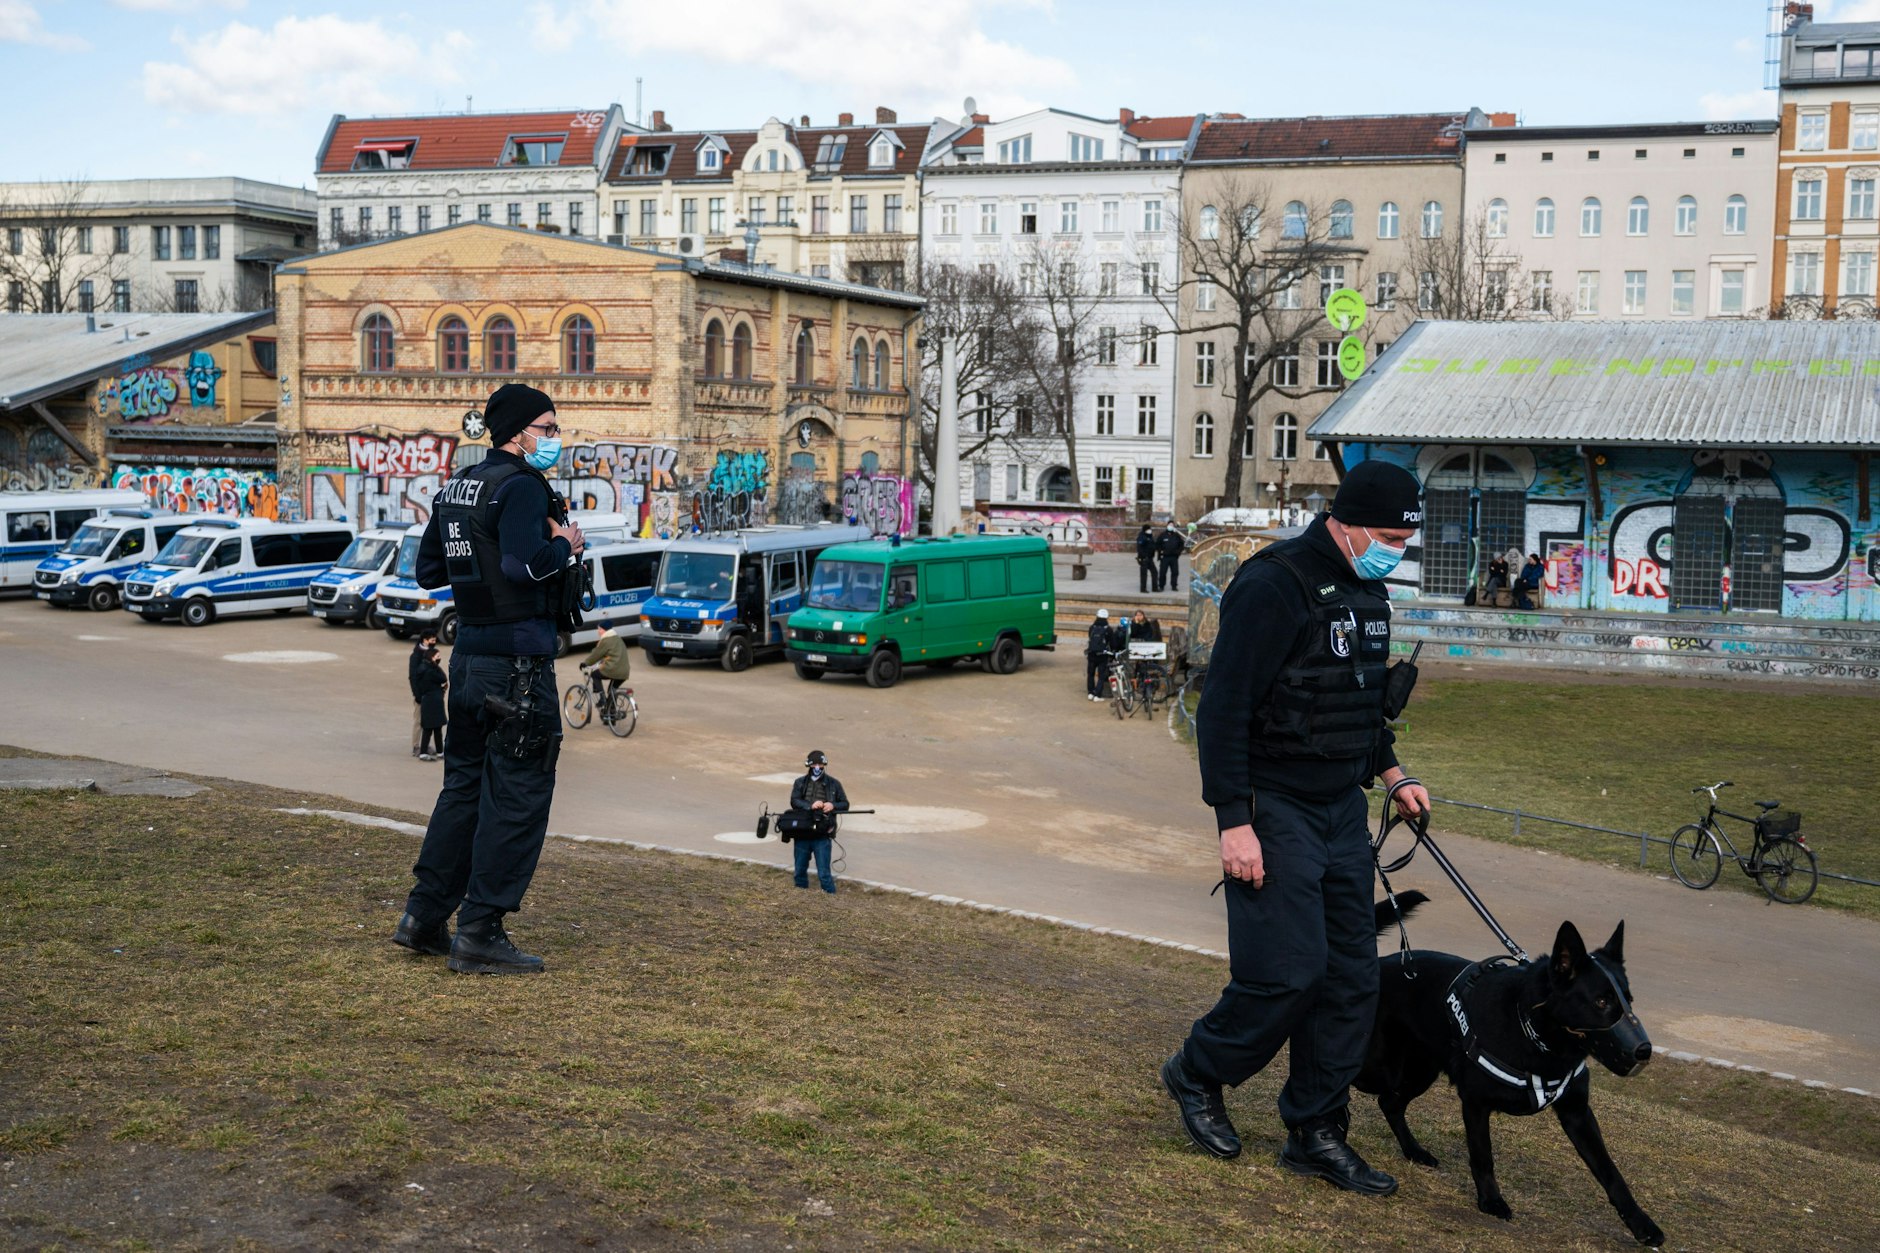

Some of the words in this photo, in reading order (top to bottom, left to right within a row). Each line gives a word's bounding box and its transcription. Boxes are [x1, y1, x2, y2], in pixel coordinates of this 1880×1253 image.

[440, 478, 484, 506] POLIZEI
[448, 521, 461, 539] BE
[264, 580, 289, 589] POLIZEI
[609, 592, 638, 605] POLIZEI
[661, 599, 703, 608] POLIZEI
[1446, 992, 1470, 1037] POLIZEI
